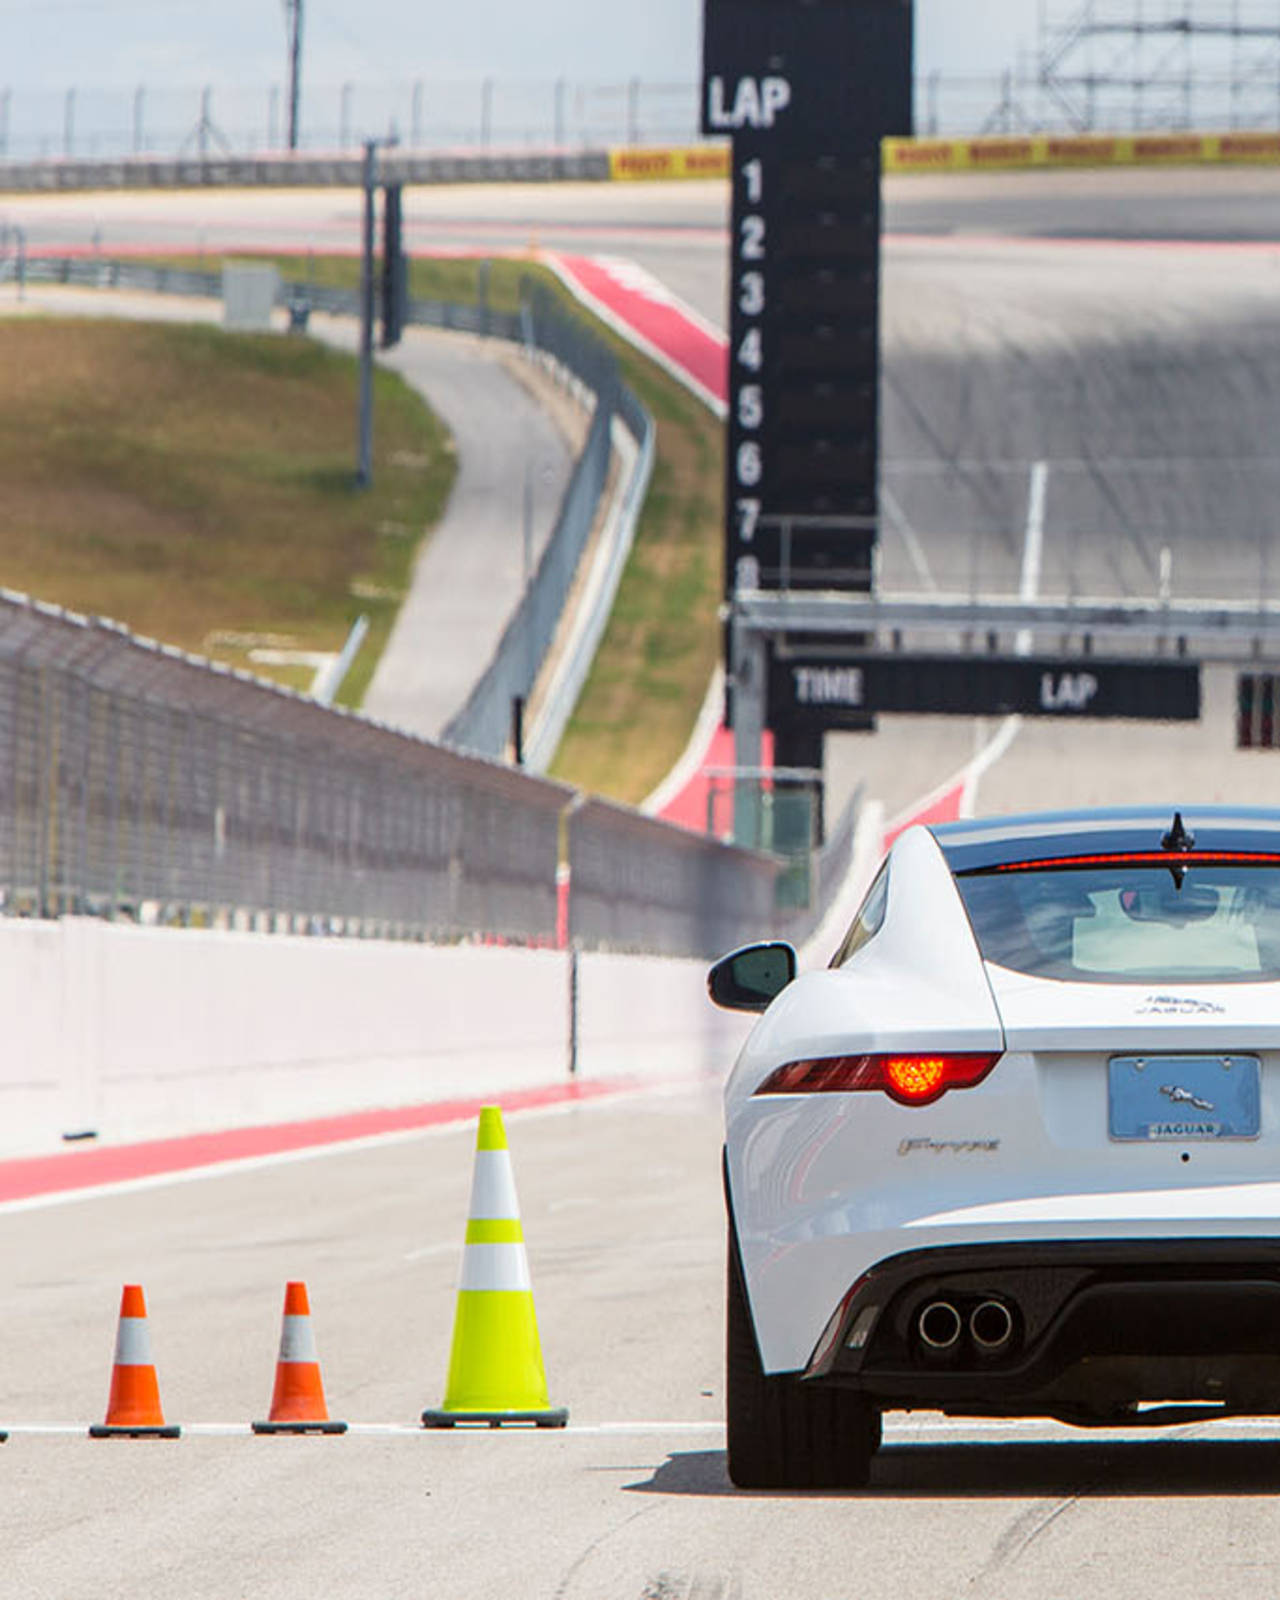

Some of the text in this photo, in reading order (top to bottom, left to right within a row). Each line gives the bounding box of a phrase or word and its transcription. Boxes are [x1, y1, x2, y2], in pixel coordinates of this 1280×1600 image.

[709, 76, 791, 129] LAP
[741, 158, 763, 203] 1
[741, 215, 765, 260] 2
[740, 272, 765, 315] 3
[738, 328, 763, 371] 4
[738, 384, 762, 428] 5
[736, 441, 762, 486] 6
[735, 498, 760, 542] 7
[793, 666, 1099, 709] TIME LAP
[1152, 1125, 1215, 1136] JAGUAR
